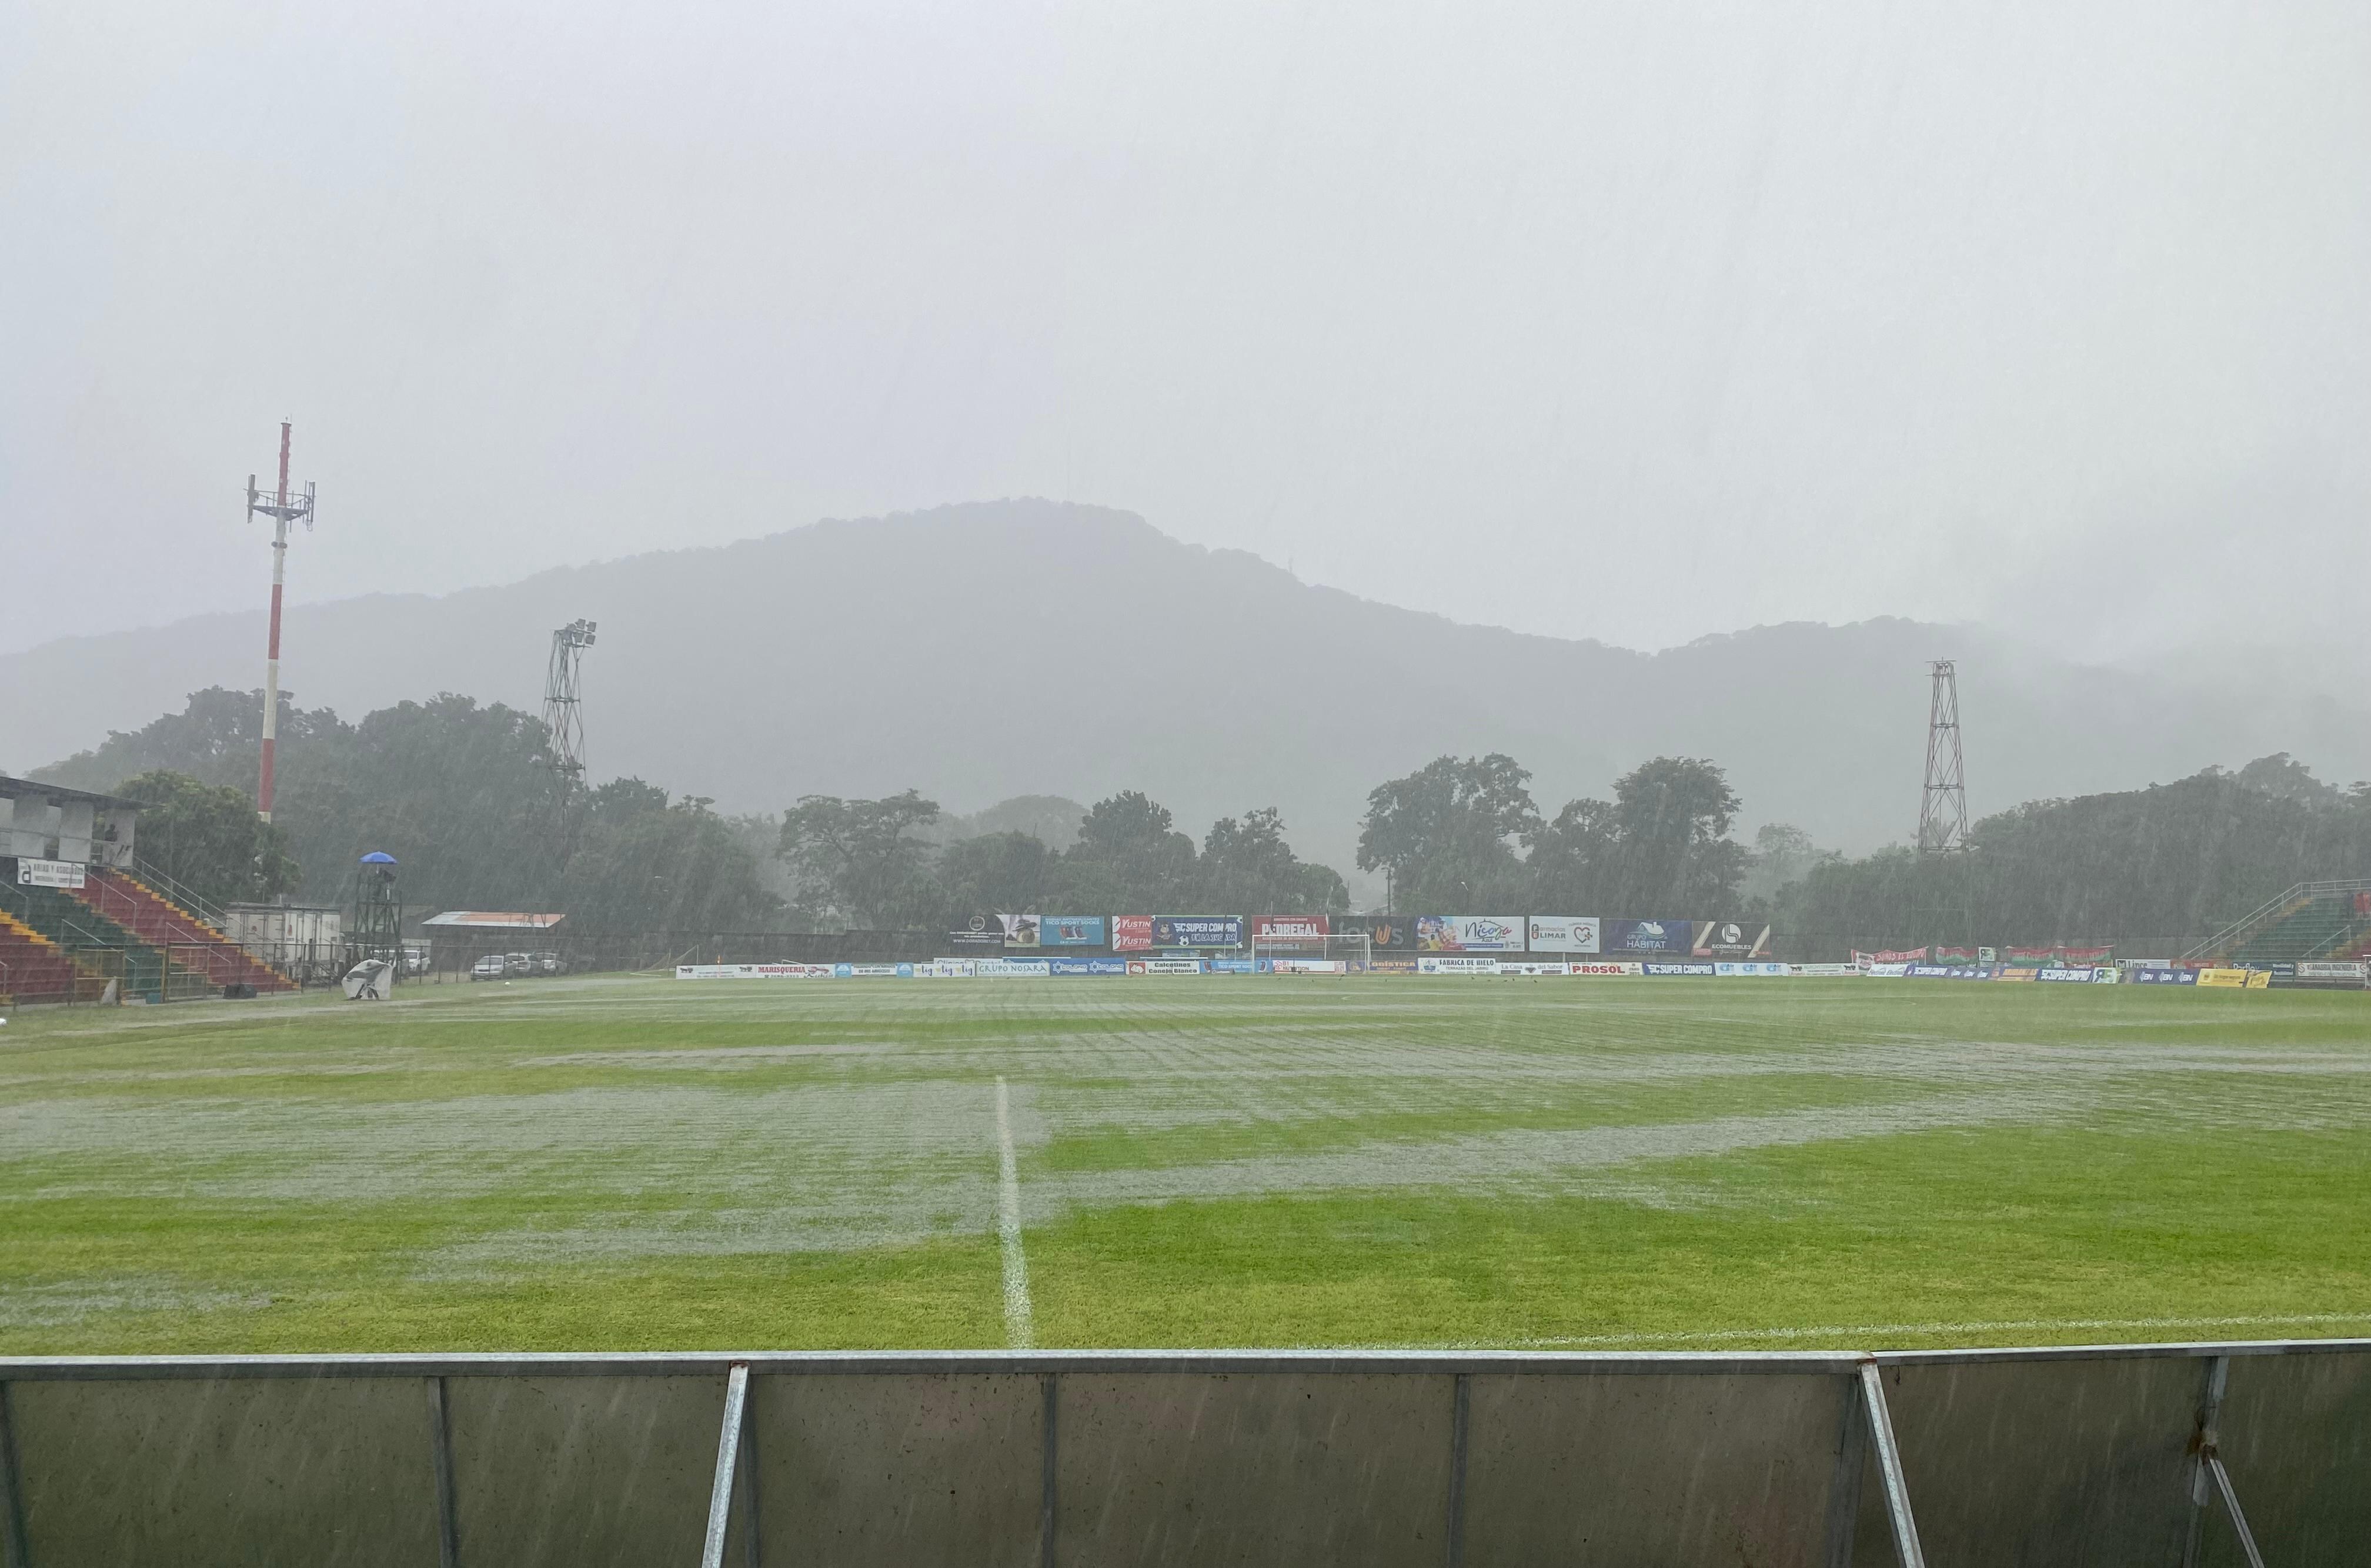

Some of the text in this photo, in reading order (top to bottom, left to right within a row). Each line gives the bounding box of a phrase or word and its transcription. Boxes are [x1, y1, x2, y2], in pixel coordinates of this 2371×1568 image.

[1122, 919, 1151, 928] YUSTIN
[1186, 922, 1207, 932] SUPER
[1122, 936, 1151, 945] YUSTIN
[1660, 965, 1682, 974] SUPER
[1683, 965, 1712, 974] COMPRO
